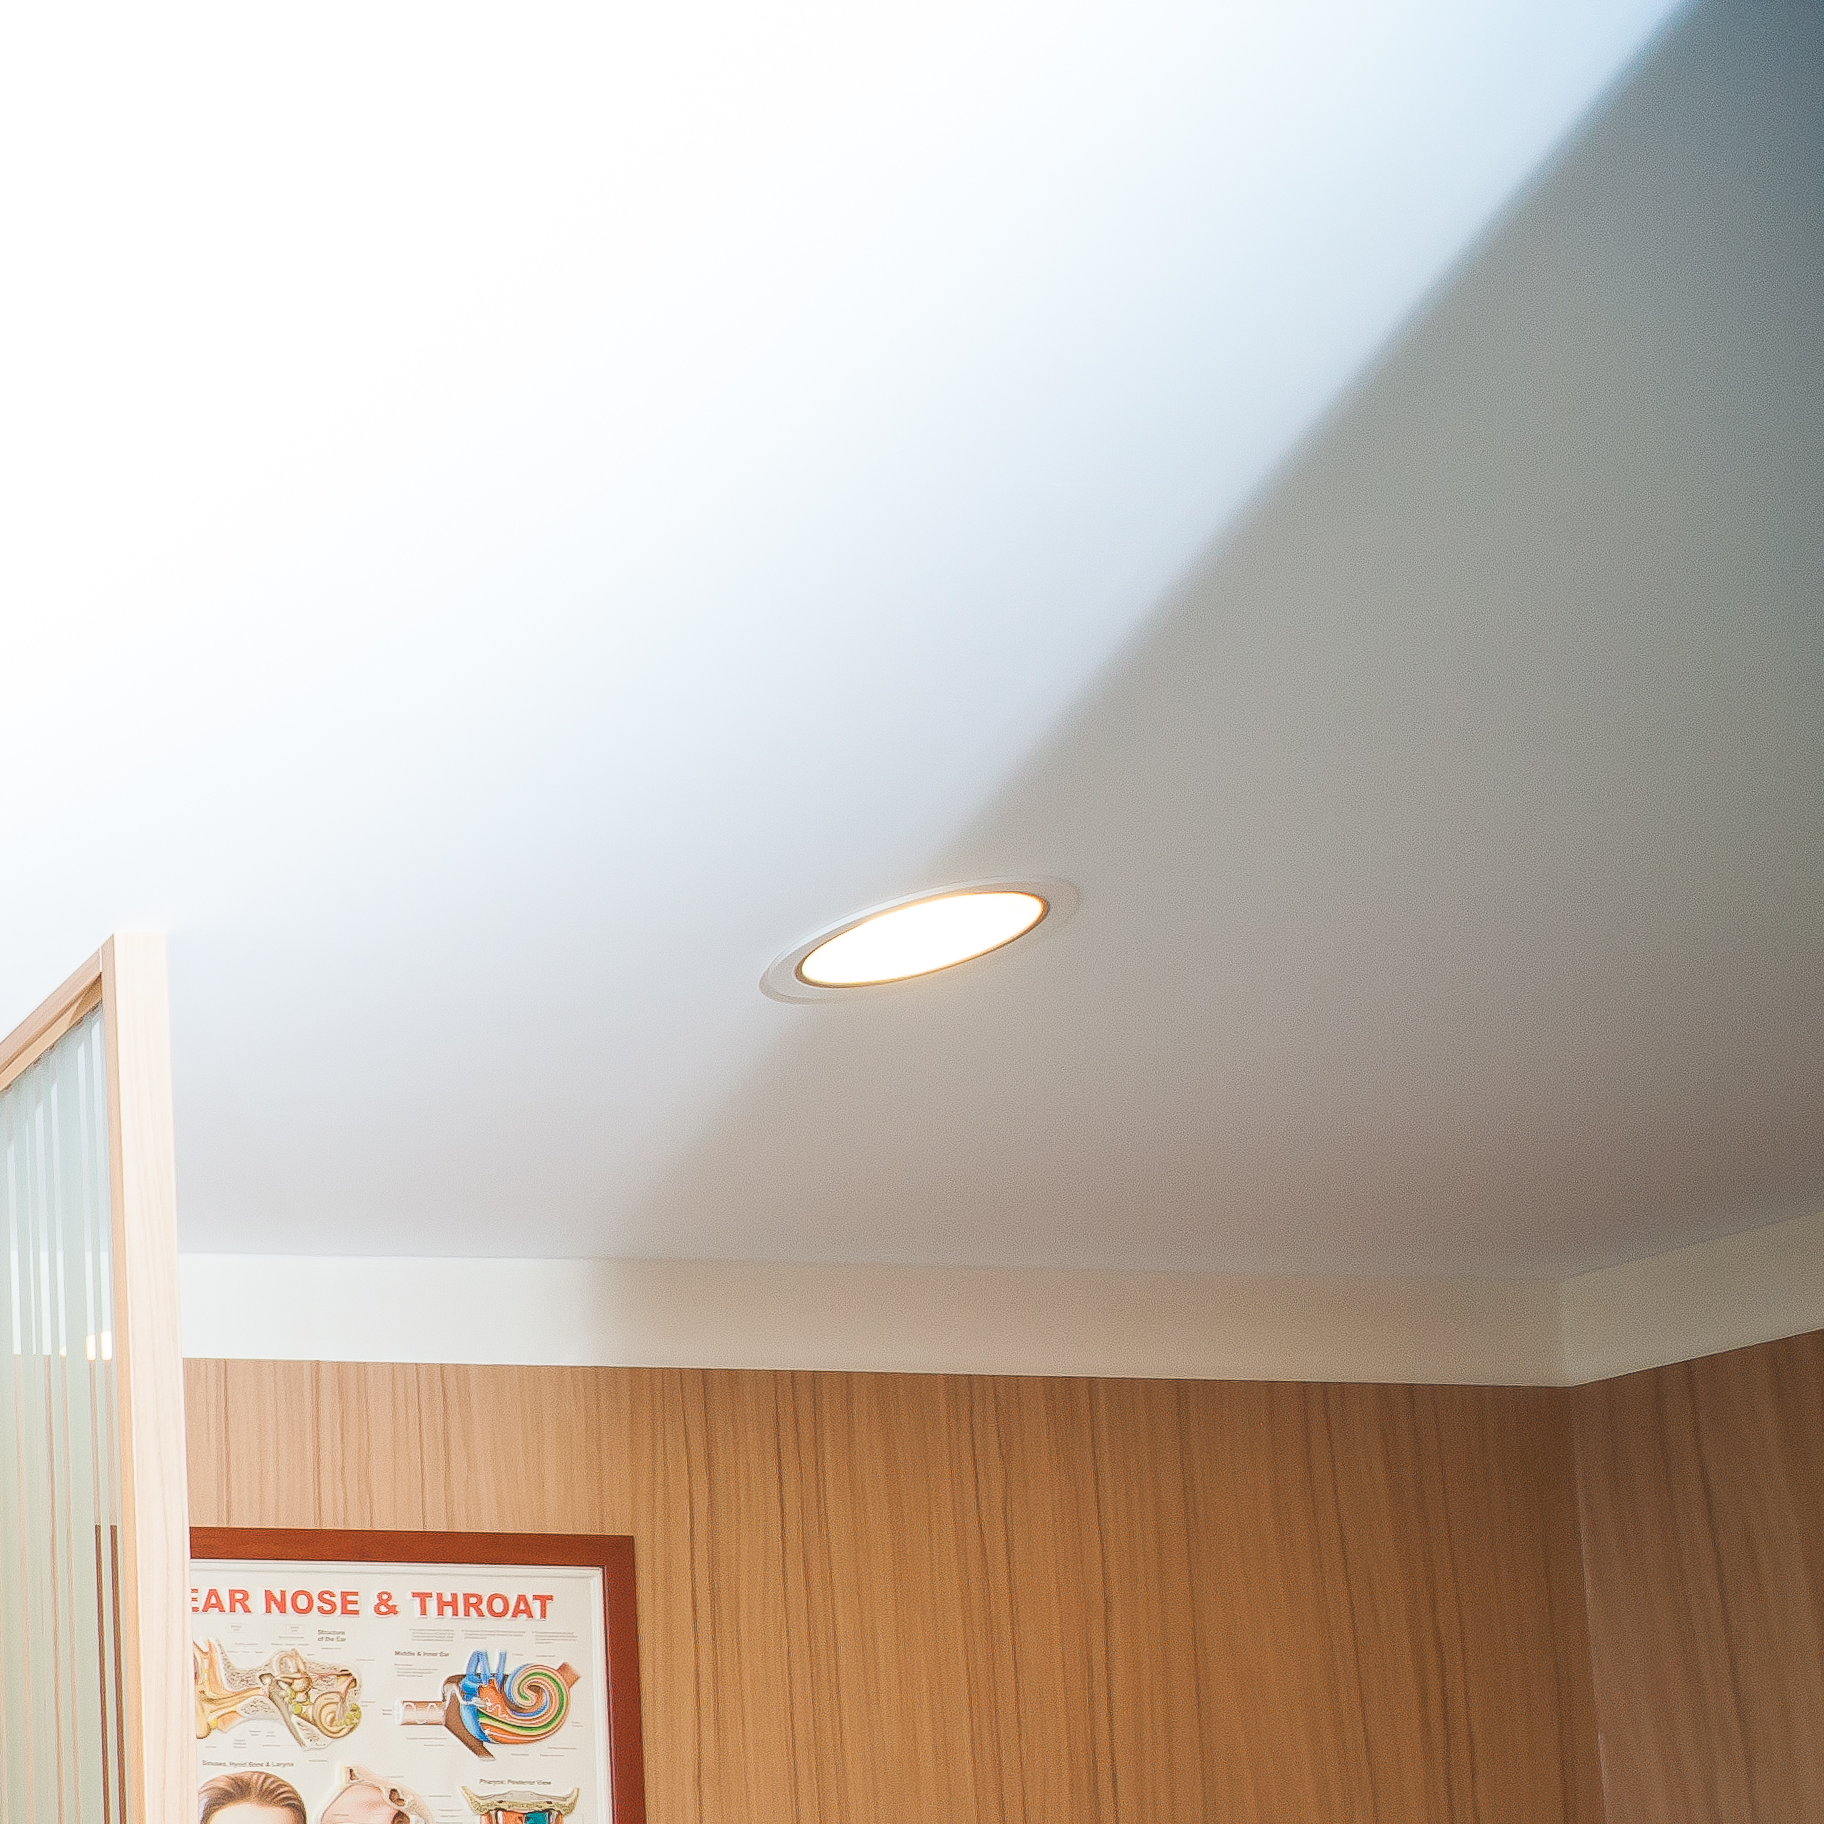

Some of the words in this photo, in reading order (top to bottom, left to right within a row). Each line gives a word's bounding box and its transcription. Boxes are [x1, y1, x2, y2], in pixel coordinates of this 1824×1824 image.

[264, 1589, 360, 1615] NOSE
[374, 1591, 399, 1615] &
[411, 1591, 554, 1619] THROAT
